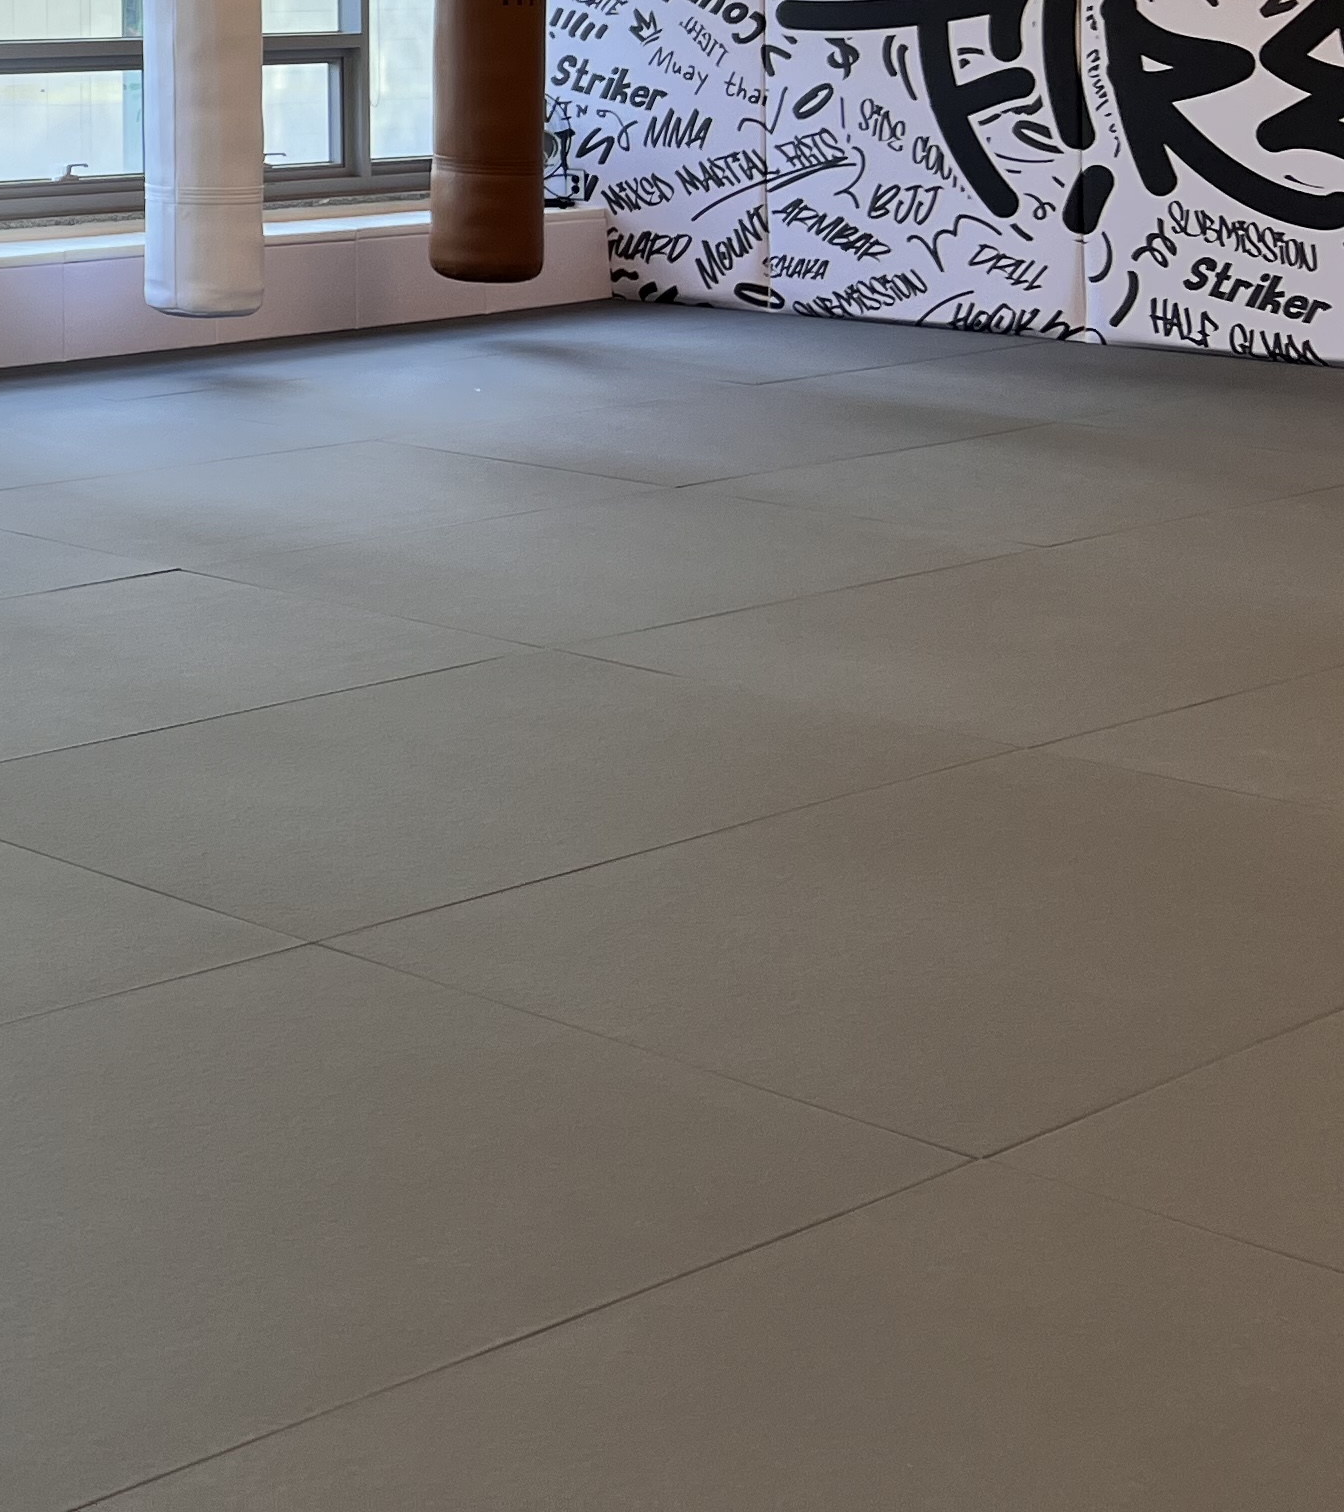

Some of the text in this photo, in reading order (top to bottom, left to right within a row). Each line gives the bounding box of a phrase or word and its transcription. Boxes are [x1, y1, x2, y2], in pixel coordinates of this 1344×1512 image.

[679, 16, 730, 67] LIGHT
[550, 54, 668, 111] Striker
[648, 46, 709, 96] Muay
[643, 107, 713, 151] MMA
[867, 182, 944, 226] BJJ
[695, 204, 771, 290] MOUNT
[772, 198, 892, 262] ARMBAR
[968, 244, 1049, 291] DRILL
[1183, 256, 1333, 324] Striker
